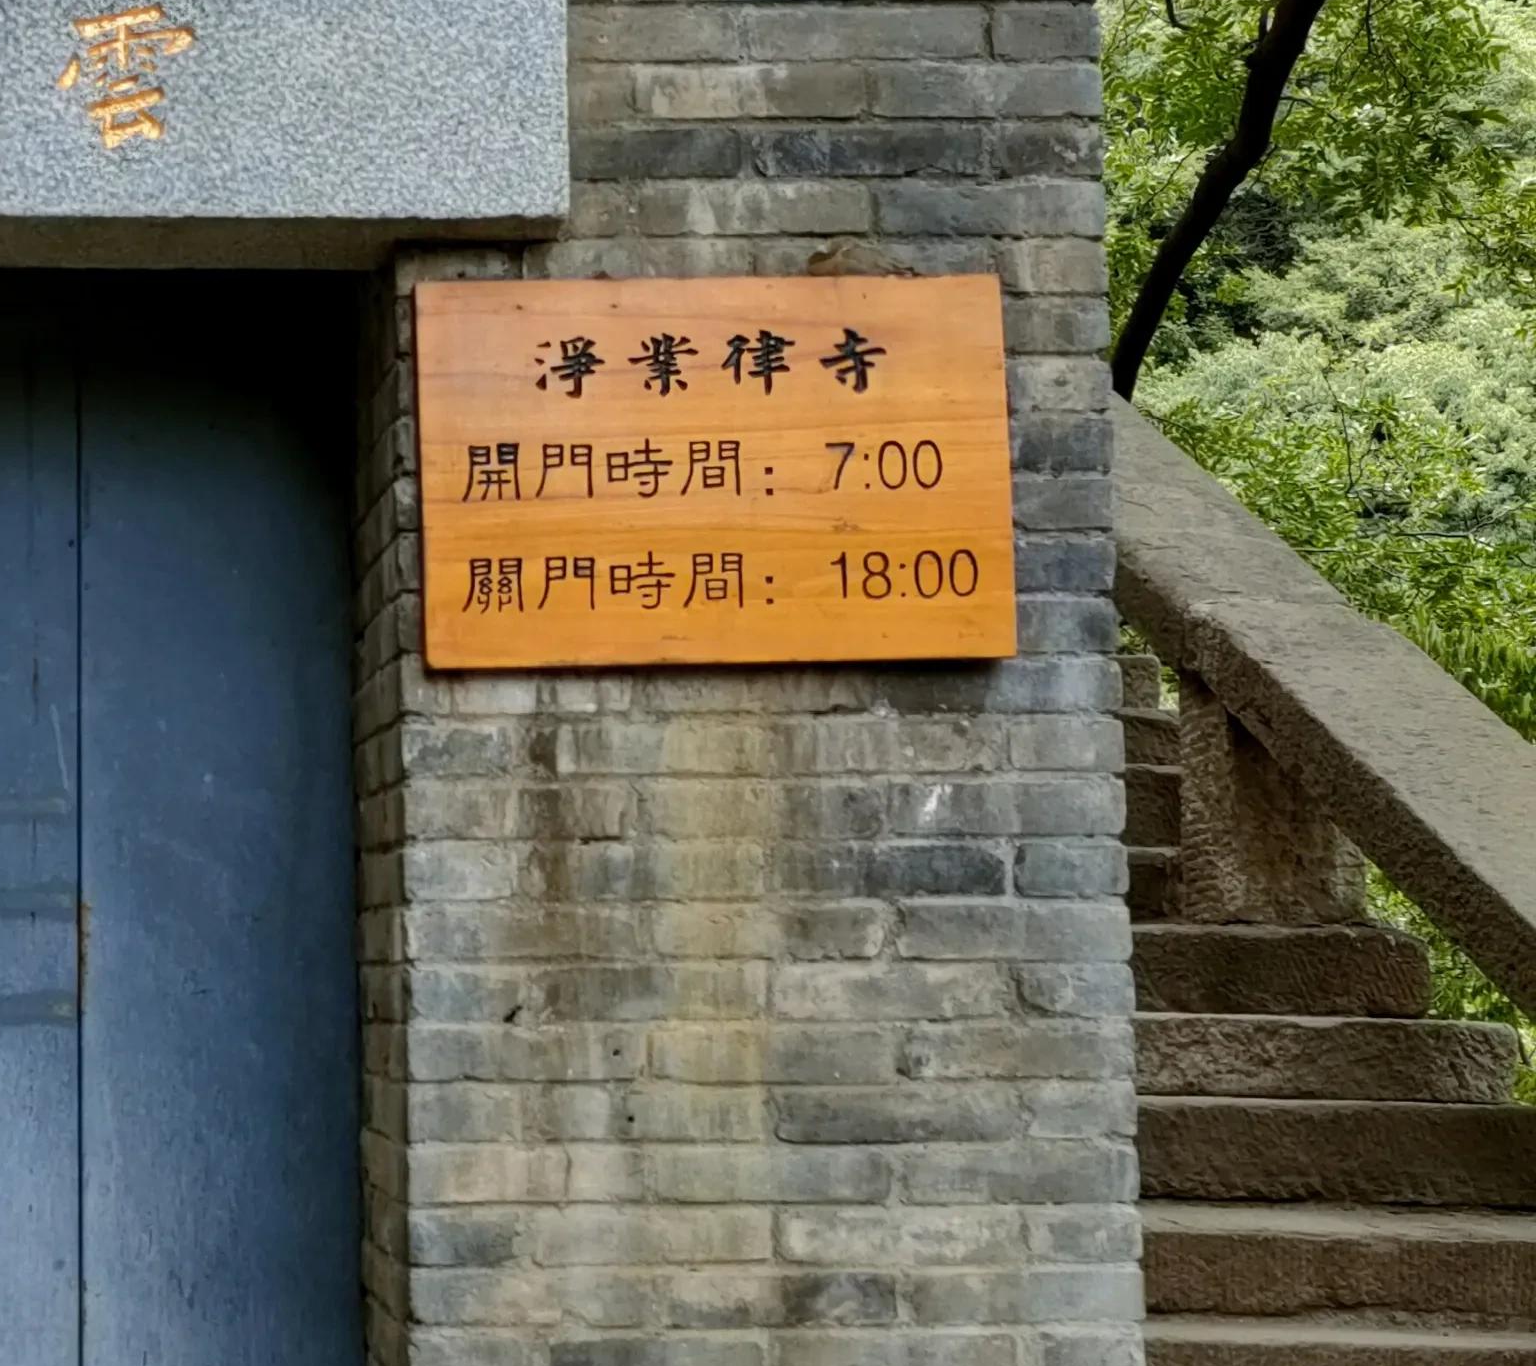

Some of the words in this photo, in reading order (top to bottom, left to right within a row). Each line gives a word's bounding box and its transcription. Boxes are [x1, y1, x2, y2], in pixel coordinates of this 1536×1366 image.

[56, 4, 195, 150] 雲
[534, 328, 887, 398] 淨業律寺
[825, 439, 943, 492] 7:00
[830, 548, 980, 600] 18:00
